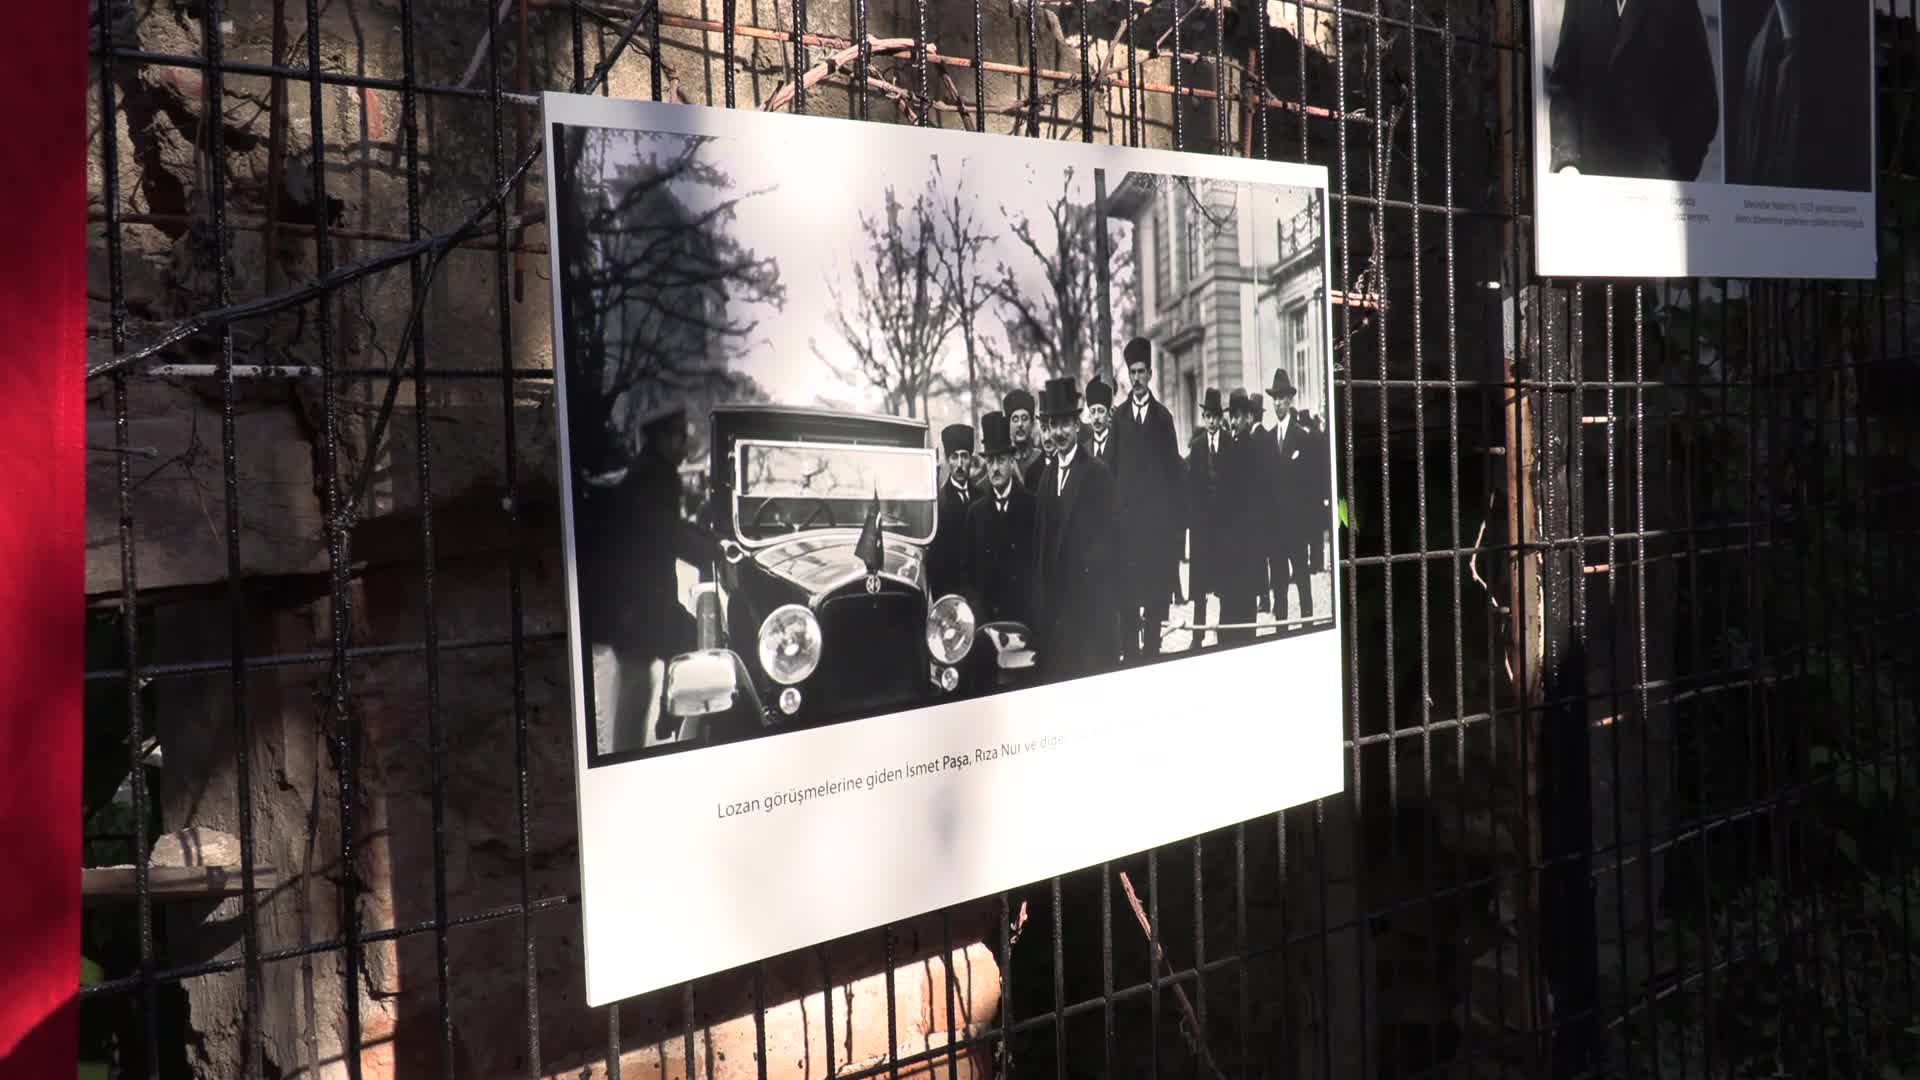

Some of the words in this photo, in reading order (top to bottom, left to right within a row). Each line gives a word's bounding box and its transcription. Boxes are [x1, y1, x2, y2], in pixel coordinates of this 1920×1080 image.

[718, 799, 760, 819] Lozan
[764, 777, 863, 813] görüşmelerine
[866, 768, 903, 790] giden
[943, 754, 972, 771] Paşa,
[975, 748, 998, 762] Rıza
